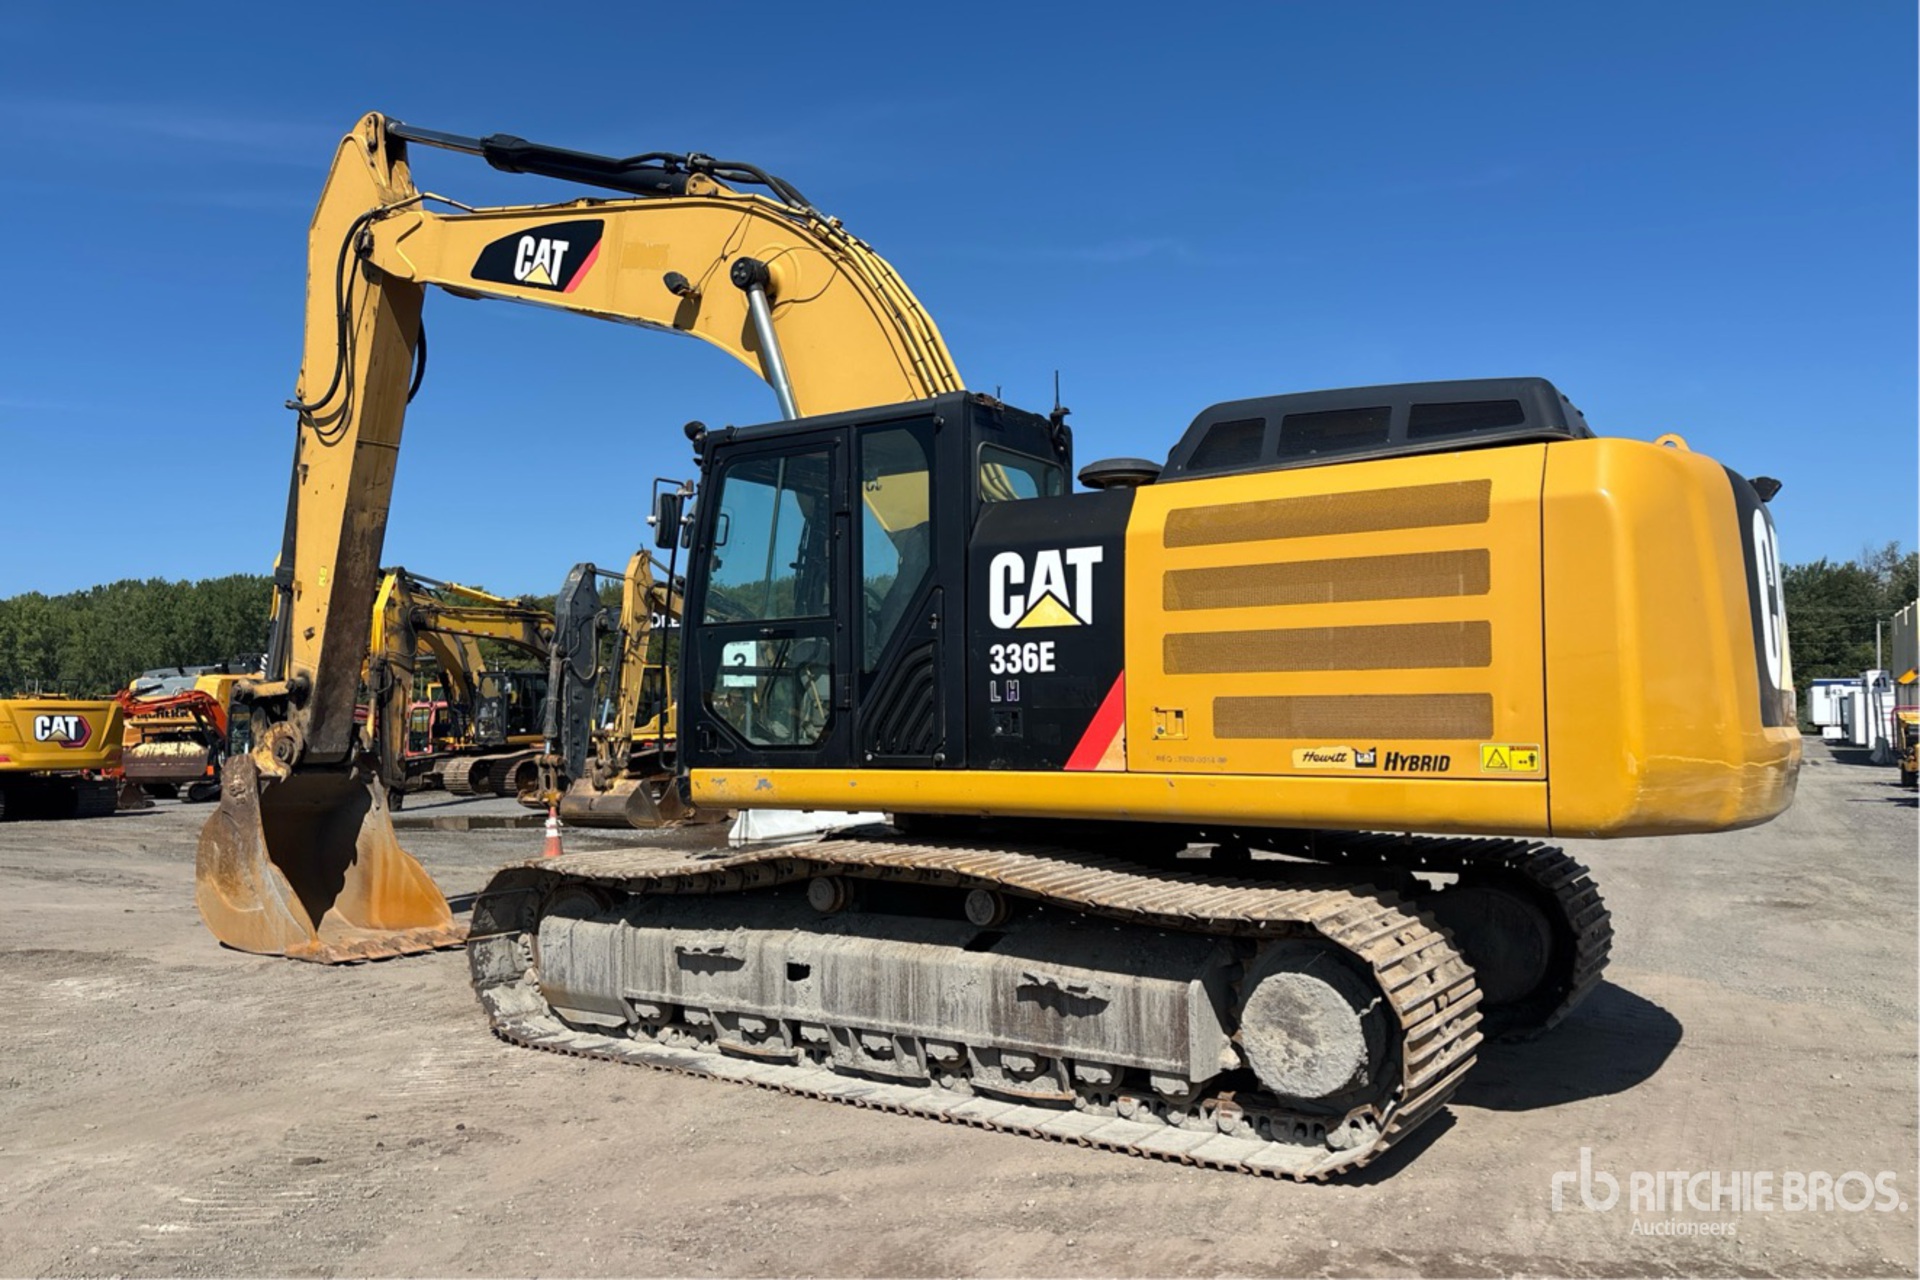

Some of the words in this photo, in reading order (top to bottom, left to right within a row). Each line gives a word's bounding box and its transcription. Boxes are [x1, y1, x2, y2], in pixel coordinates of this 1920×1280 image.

[513, 235, 570, 287] CAT
[989, 546, 1104, 630] CAT
[990, 641, 1056, 675] 336E
[35, 715, 80, 742] CAT
[1302, 751, 1347, 763] Hewitt
[1384, 751, 1451, 772] HYBRID
